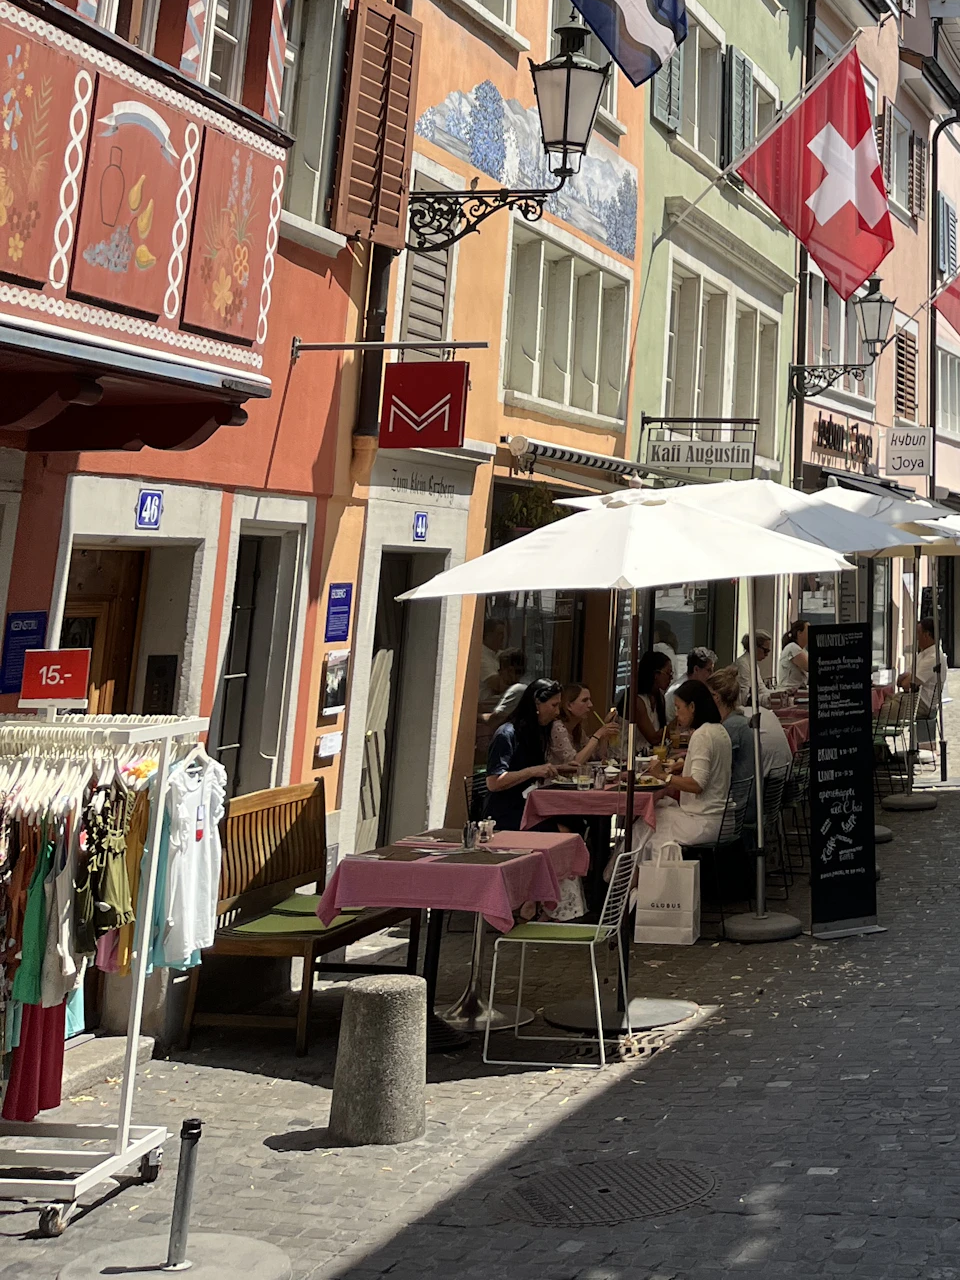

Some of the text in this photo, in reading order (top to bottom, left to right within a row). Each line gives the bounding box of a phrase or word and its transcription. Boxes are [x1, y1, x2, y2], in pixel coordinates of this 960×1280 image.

[890, 432, 927, 447] kybun
[651, 444, 751, 466] Kafi Augustin
[891, 456, 925, 471] Joya
[391, 468, 409, 493] Zum
[141, 495, 159, 523] 46
[416, 516, 427, 537] 44
[39, 665, 73, 686] 15.-
